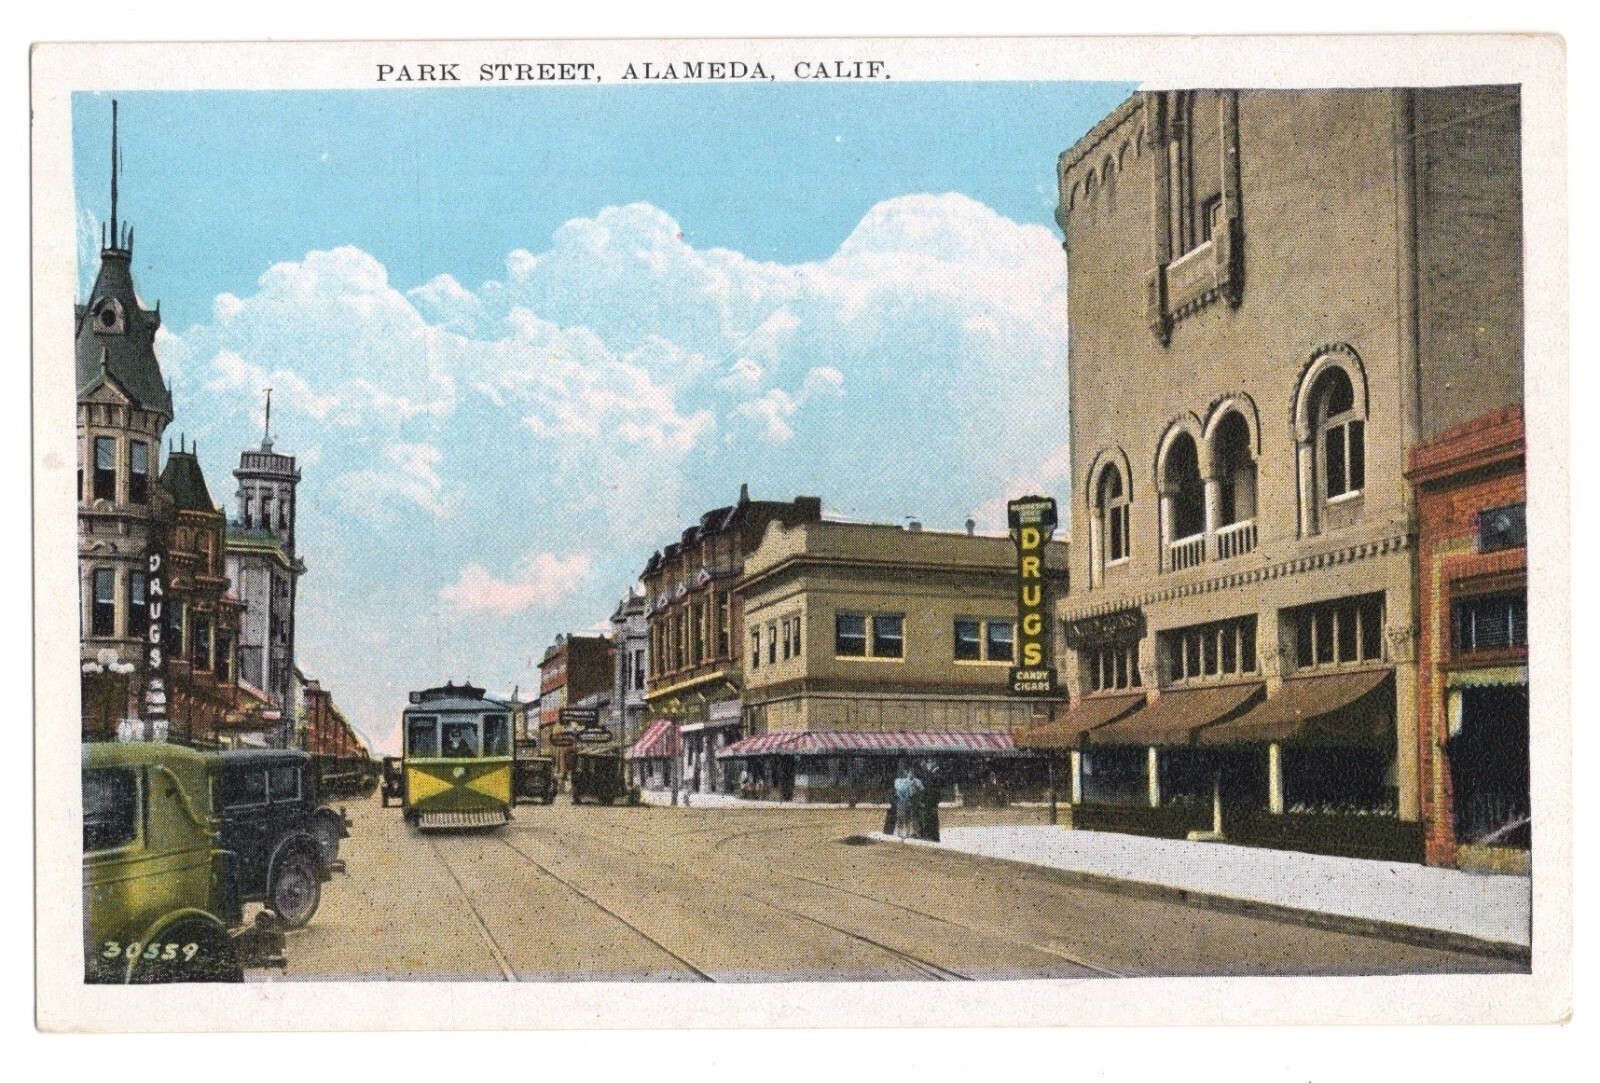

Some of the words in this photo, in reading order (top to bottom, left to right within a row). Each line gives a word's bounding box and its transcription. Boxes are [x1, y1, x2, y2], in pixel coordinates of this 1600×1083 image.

[149, 554, 163, 668] DRUGS
[1021, 527, 1043, 666] DRUGS
[1014, 682, 1050, 691] CIGARS
[1016, 670, 1049, 680] CANDY
